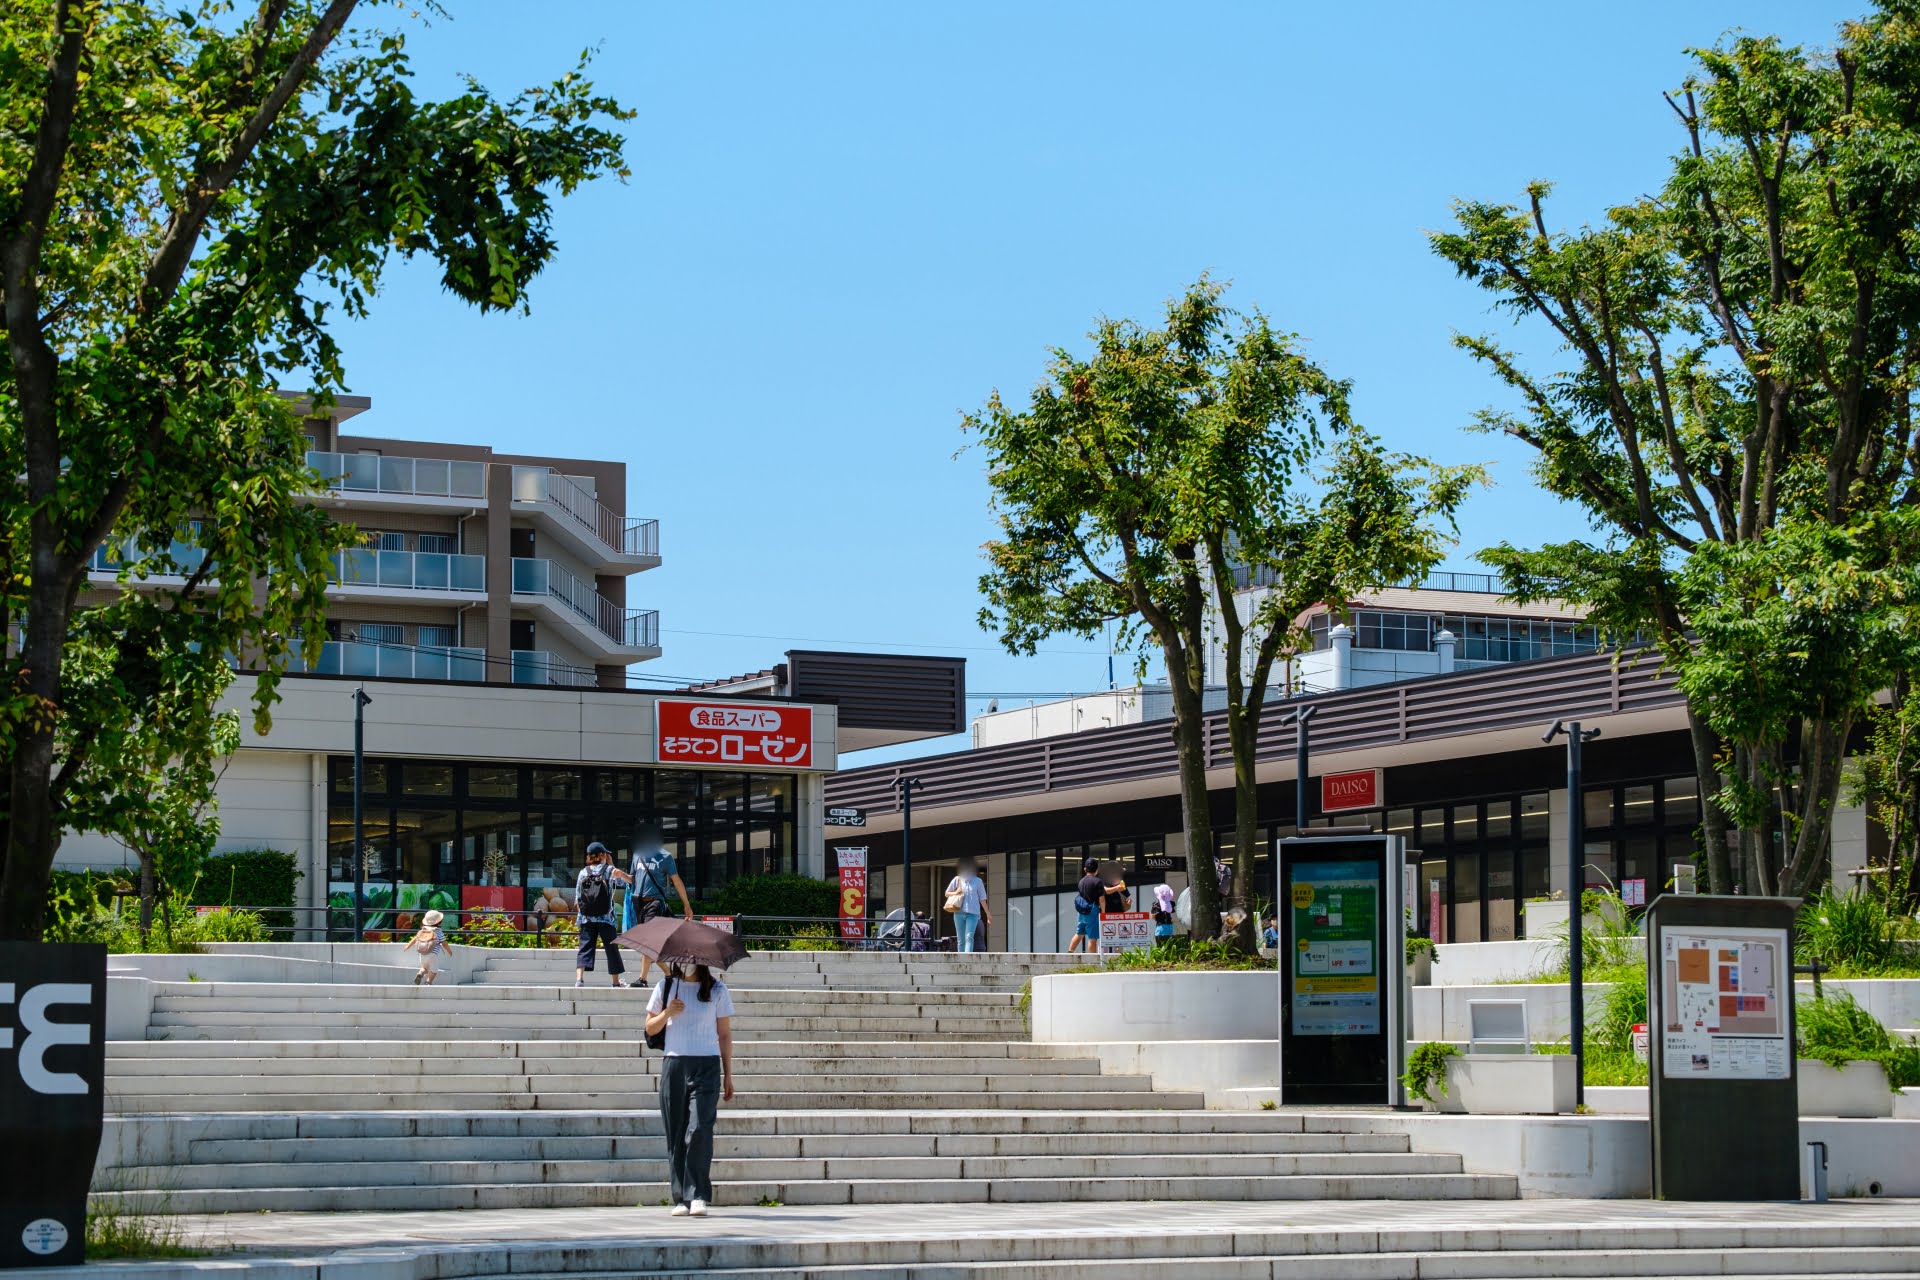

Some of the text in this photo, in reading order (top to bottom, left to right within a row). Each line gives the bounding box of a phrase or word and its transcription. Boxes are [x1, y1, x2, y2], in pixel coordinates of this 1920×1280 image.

[696, 710, 776, 728] 食品スーパー
[663, 734, 807, 763] そうてつローゼン
[1331, 778, 1368, 796] DAISO
[1146, 858, 1173, 866] DAISO
